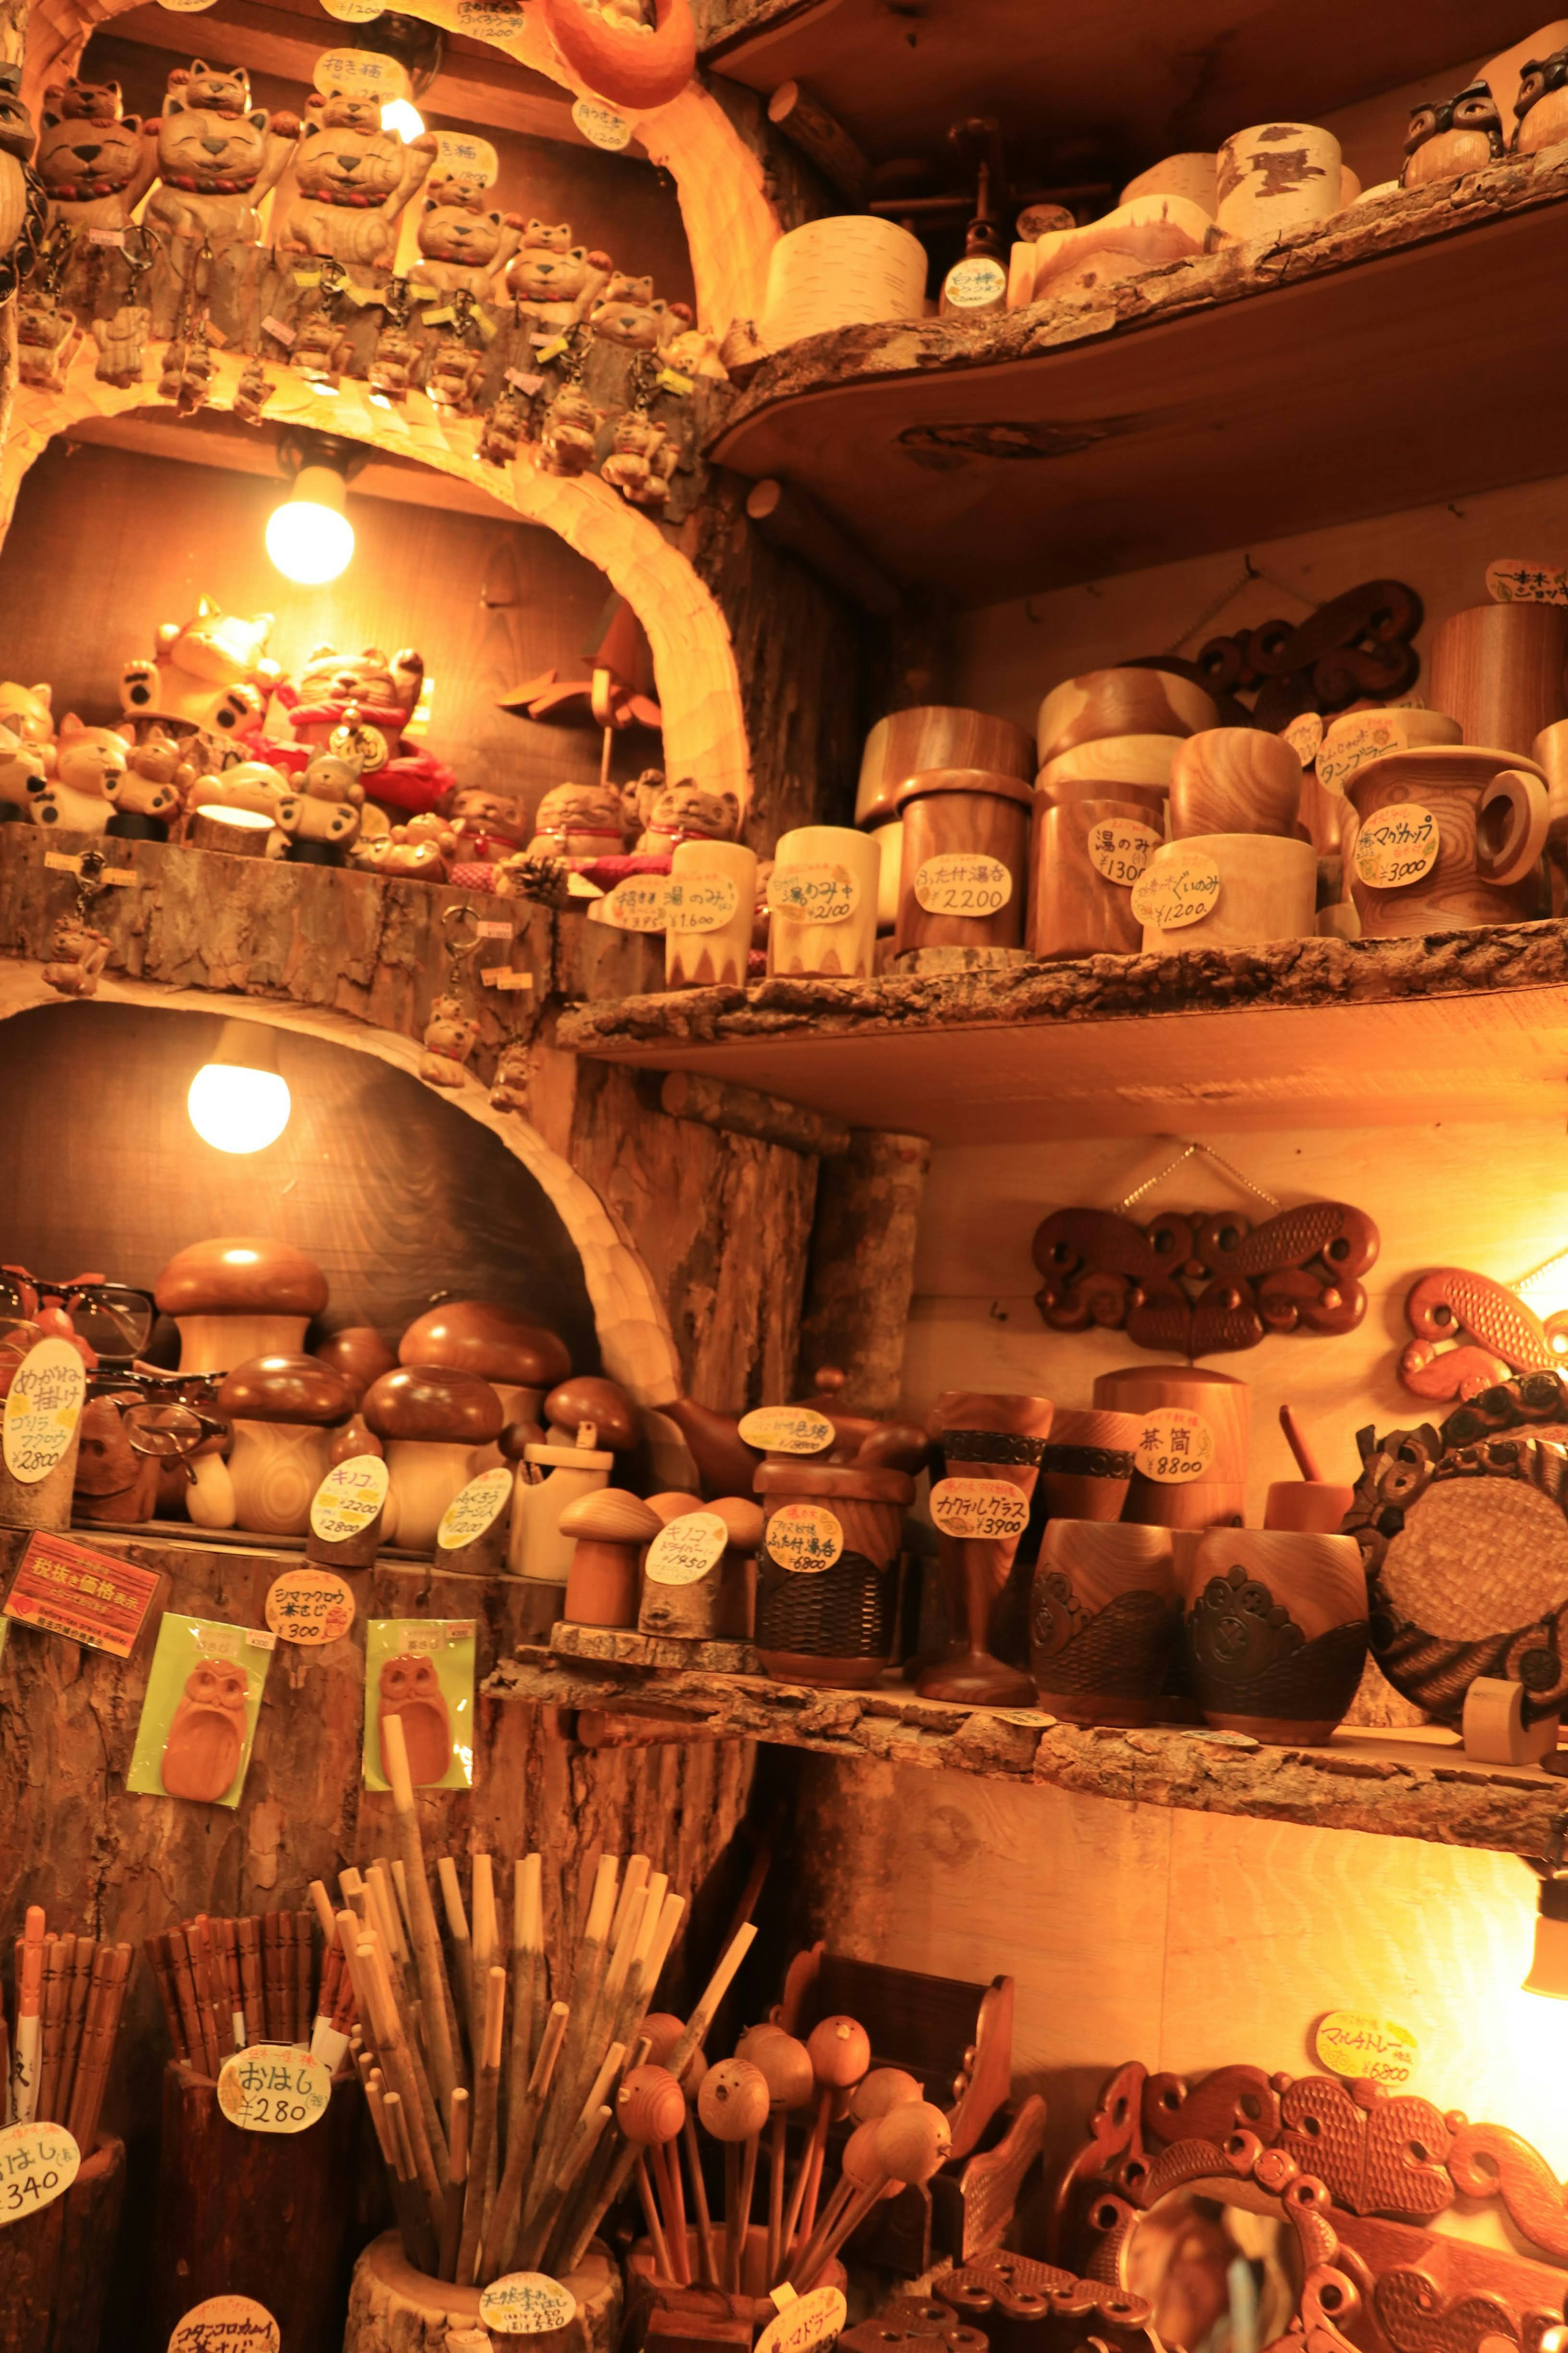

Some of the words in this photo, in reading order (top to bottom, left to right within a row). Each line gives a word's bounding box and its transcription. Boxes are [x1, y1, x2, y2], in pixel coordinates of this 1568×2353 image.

[1321, 741, 1398, 783] タンブラー
[1095, 830, 1149, 853] 湯のみ
[1374, 815, 1432, 845] マグカップ
[931, 888, 1003, 908] ¥2200
[13, 1365, 82, 1395] めがね
[32, 1386, 80, 1412] 掛け
[1147, 1456, 1202, 1475] ¥8800
[937, 1497, 1026, 1518] カクテルグラス
[31, 1557, 138, 1610] 税抜き価格表示
[239, 2061, 312, 2094] おはし
[238, 2095, 305, 2128] ¥280
[0, 2141, 56, 2181] はし
